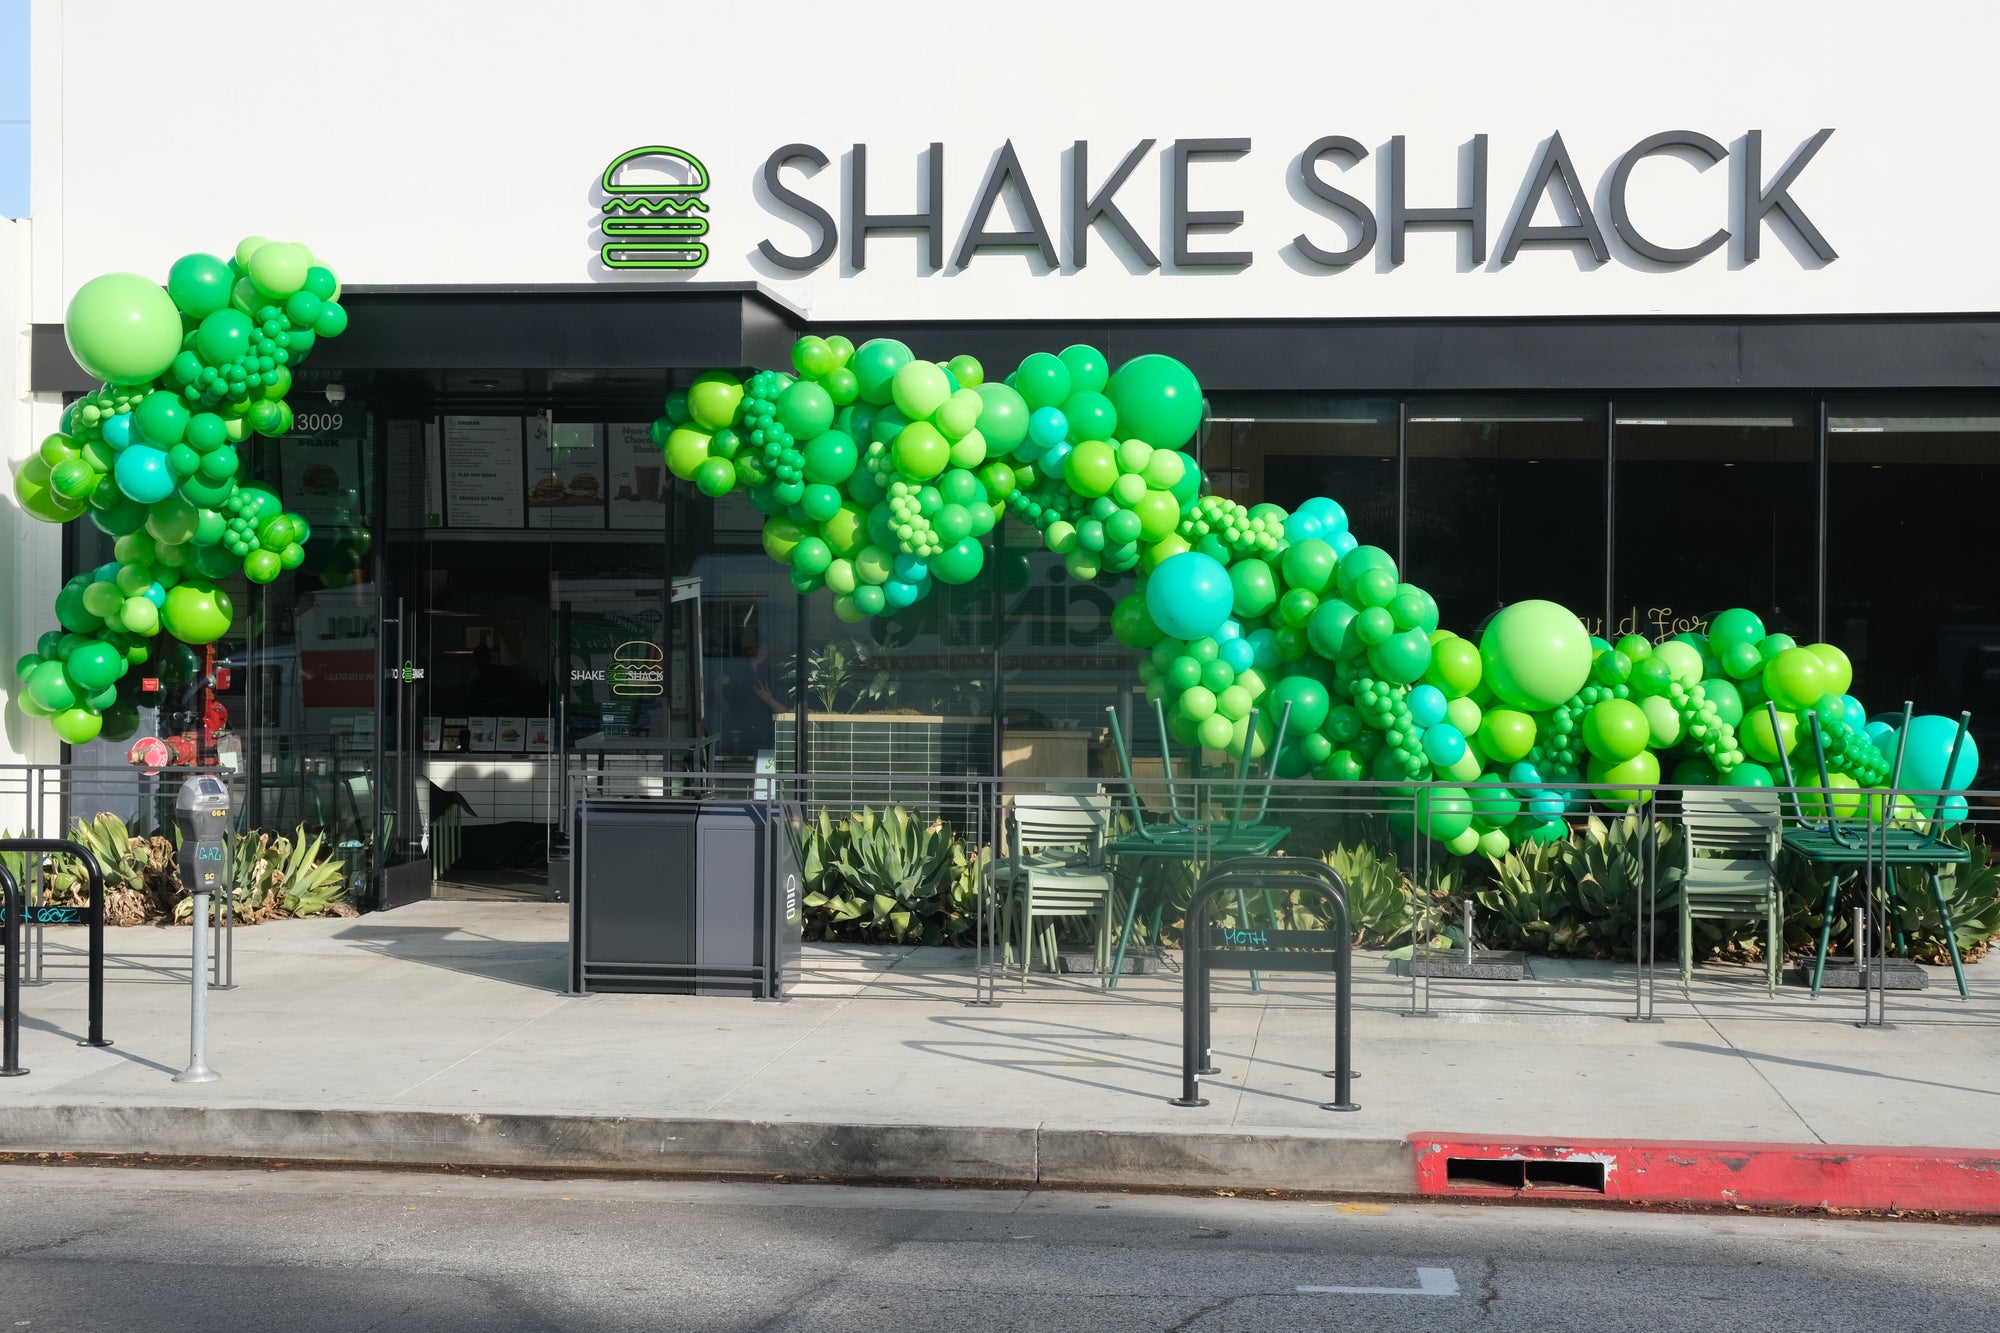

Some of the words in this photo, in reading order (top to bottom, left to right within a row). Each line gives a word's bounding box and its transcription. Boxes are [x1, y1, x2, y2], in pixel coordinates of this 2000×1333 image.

[756, 138, 1254, 270] SHAKE
[1293, 128, 1840, 266] SHACK
[290, 413, 343, 431] 13009
[570, 669, 606, 681] SHAKE
[628, 669, 664, 681] SHACK
[1223, 928, 1267, 946] MOTH
